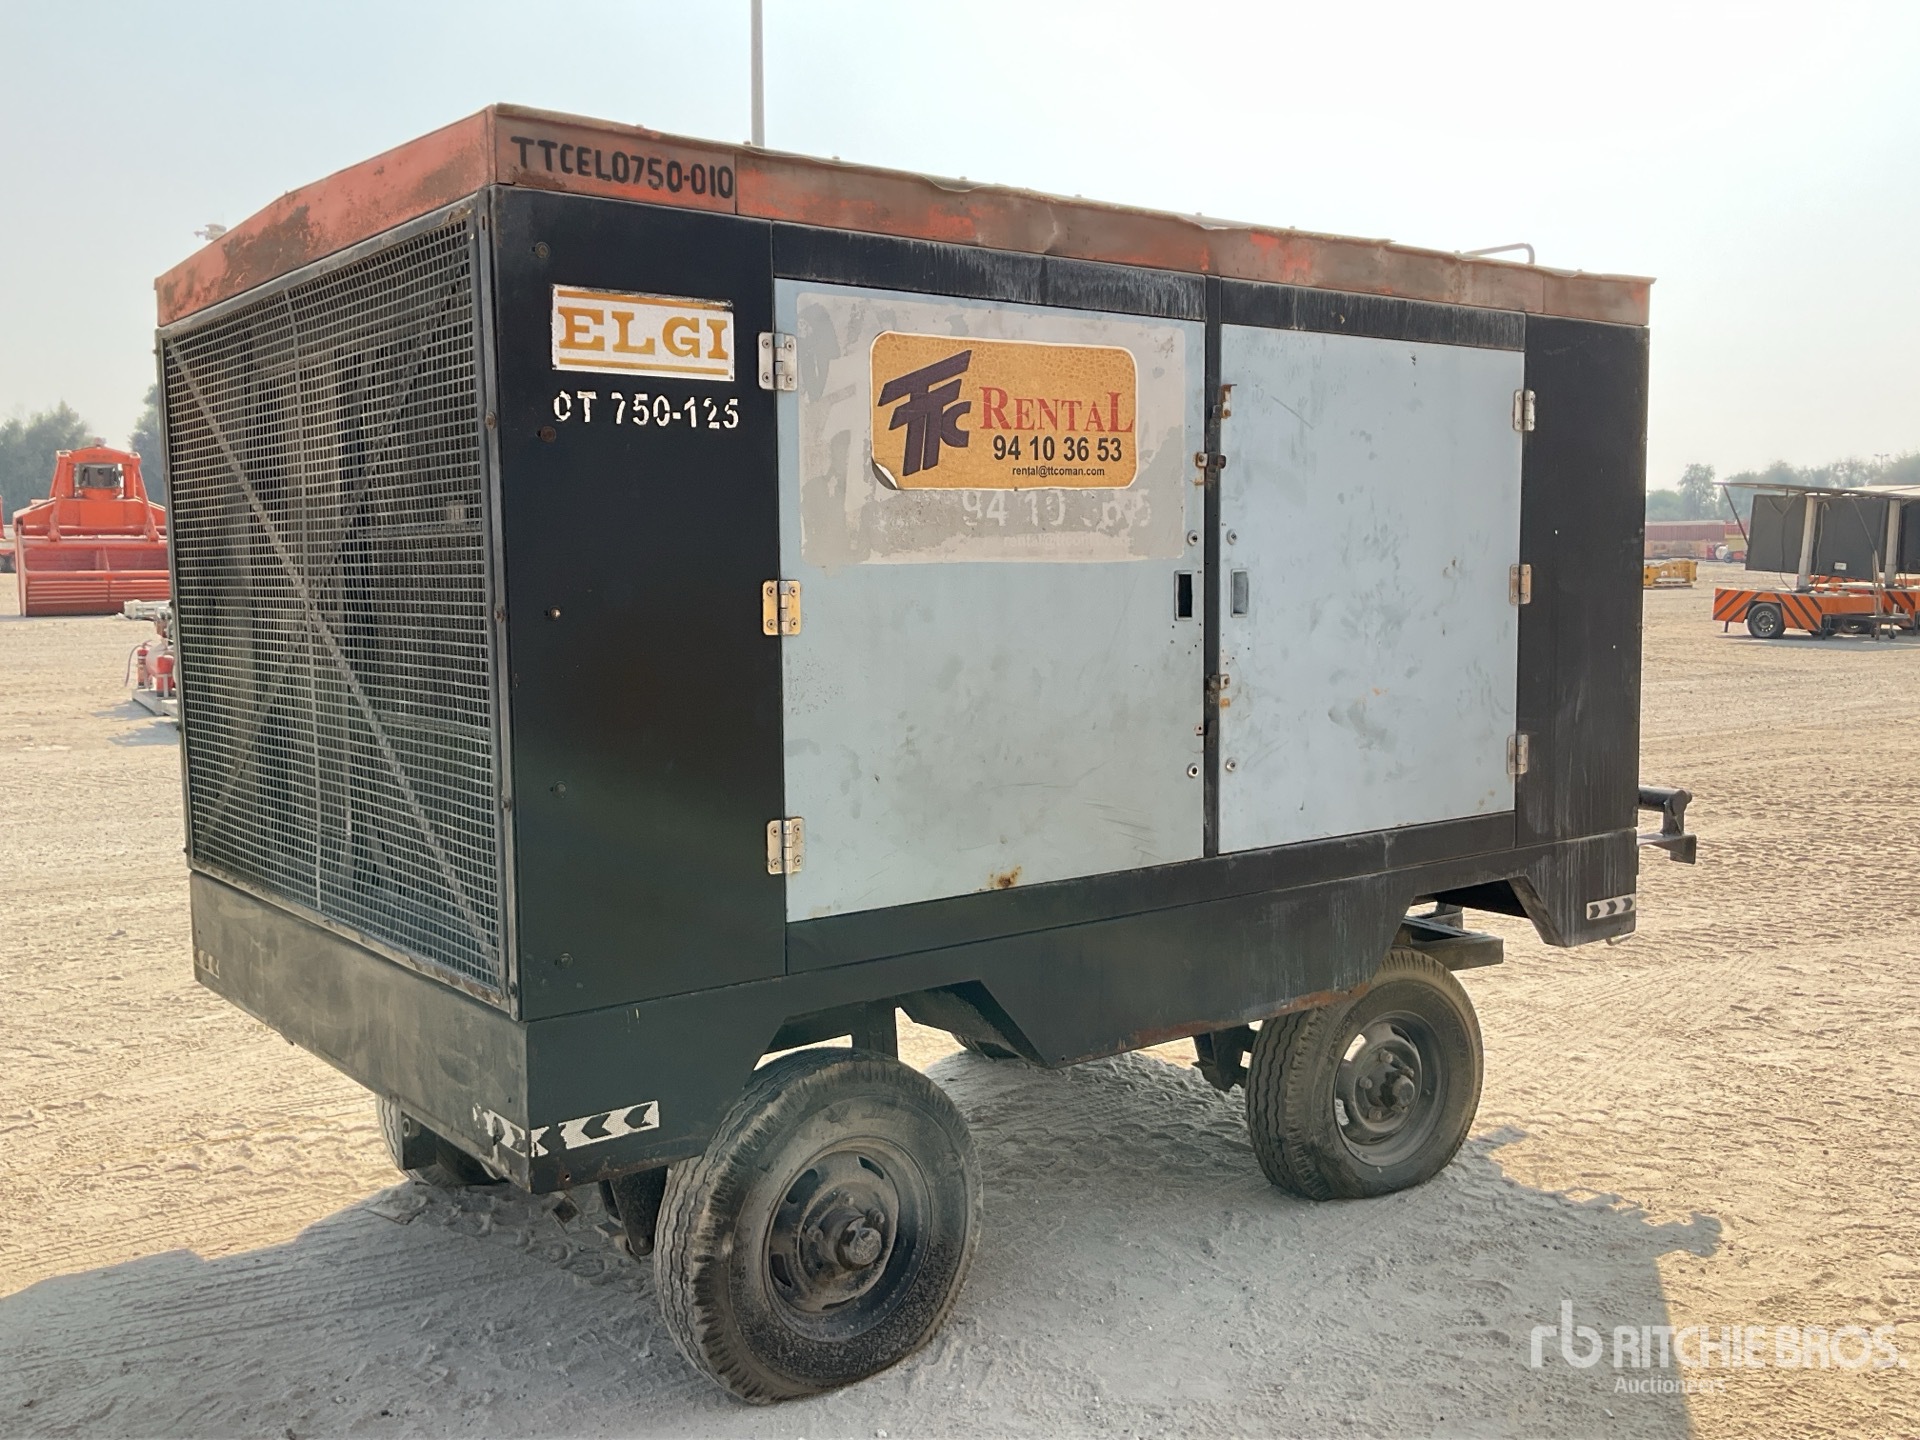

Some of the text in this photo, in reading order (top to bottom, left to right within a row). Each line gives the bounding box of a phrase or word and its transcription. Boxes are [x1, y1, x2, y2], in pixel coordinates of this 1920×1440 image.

[558, 306, 728, 360] ELGI
[610, 391, 739, 430] 750-125
[992, 434, 1123, 462] 94 10 36 53
[1012, 465, 1105, 477] rental@ttcoman.com
